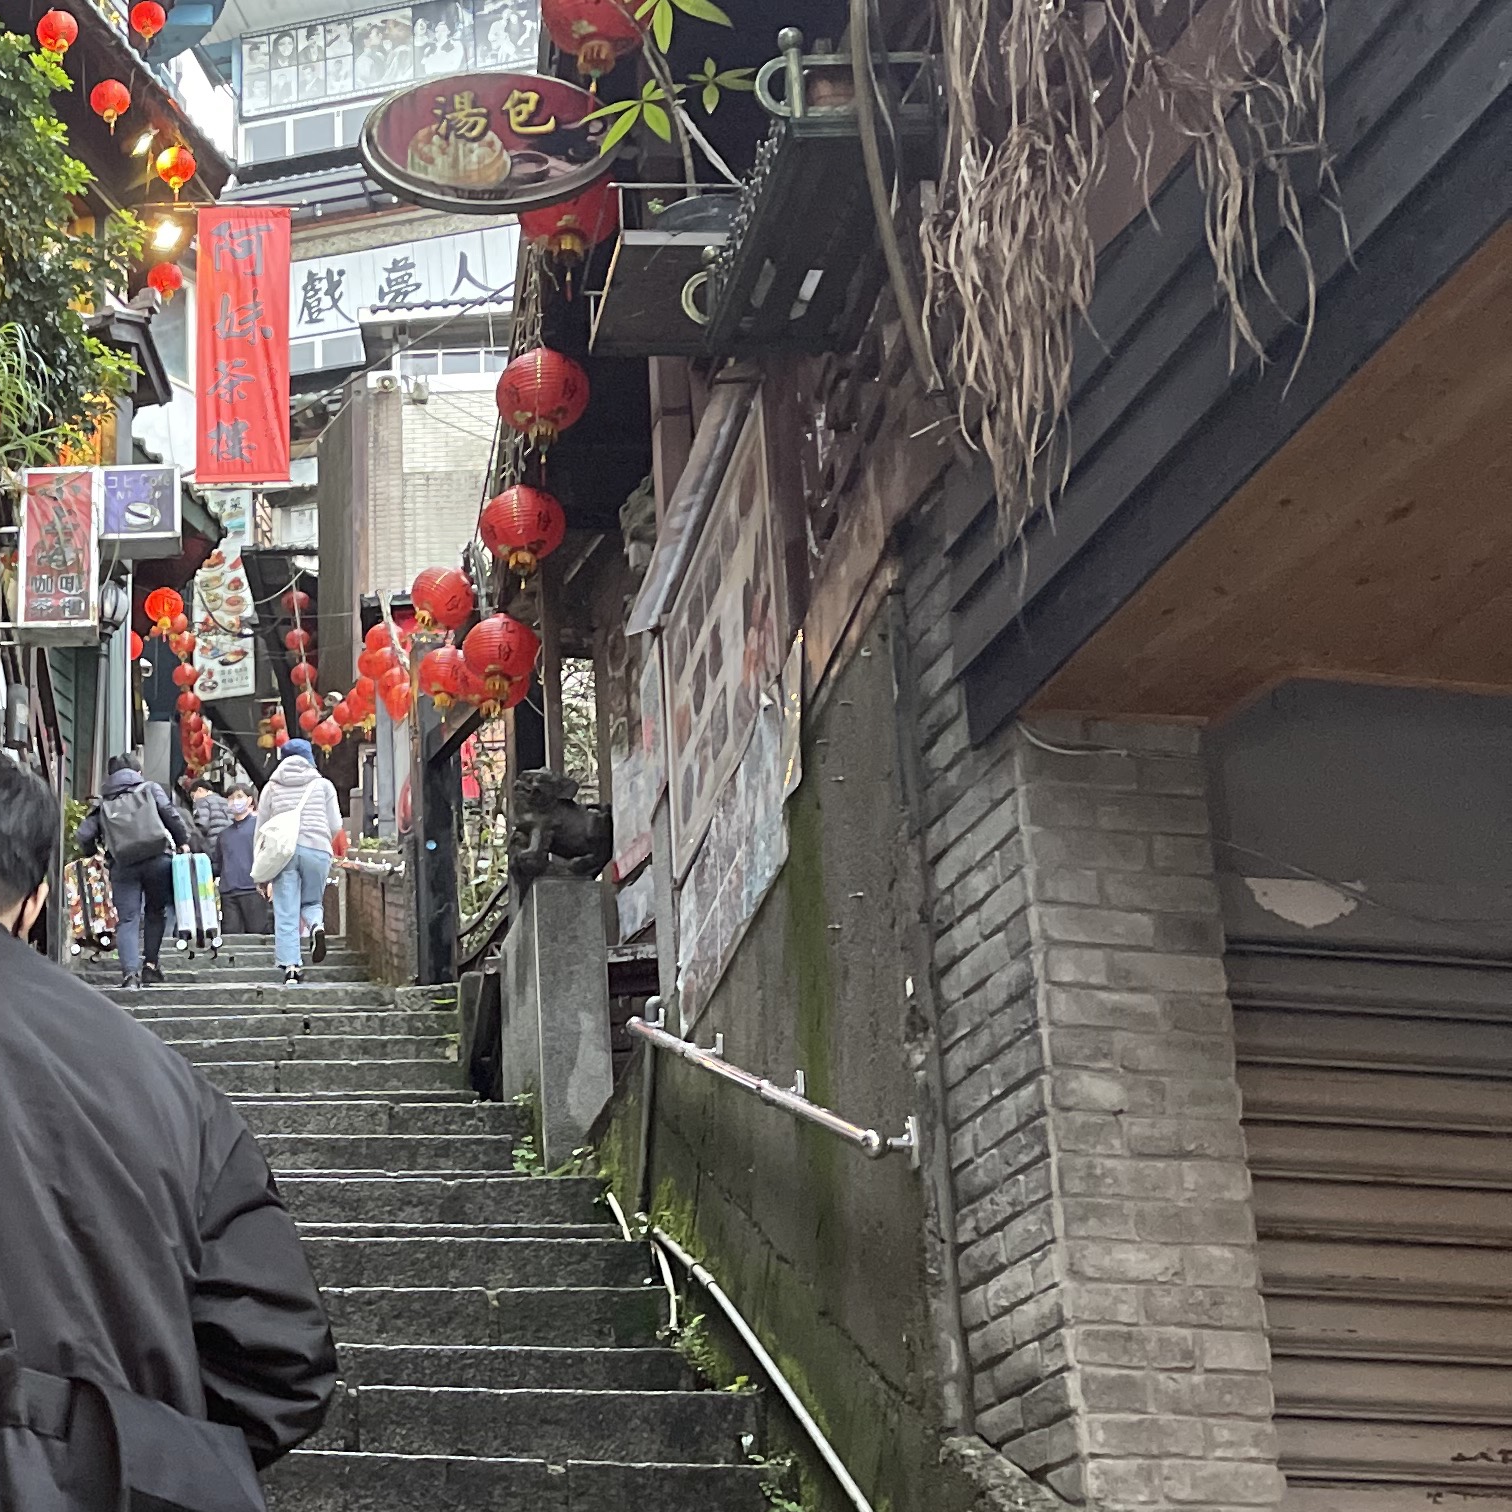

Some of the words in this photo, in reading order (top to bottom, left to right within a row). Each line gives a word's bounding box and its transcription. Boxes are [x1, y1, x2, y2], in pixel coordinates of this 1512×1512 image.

[433, 89, 556, 139] 湯包
[207, 221, 274, 464] 阿妹茶樓
